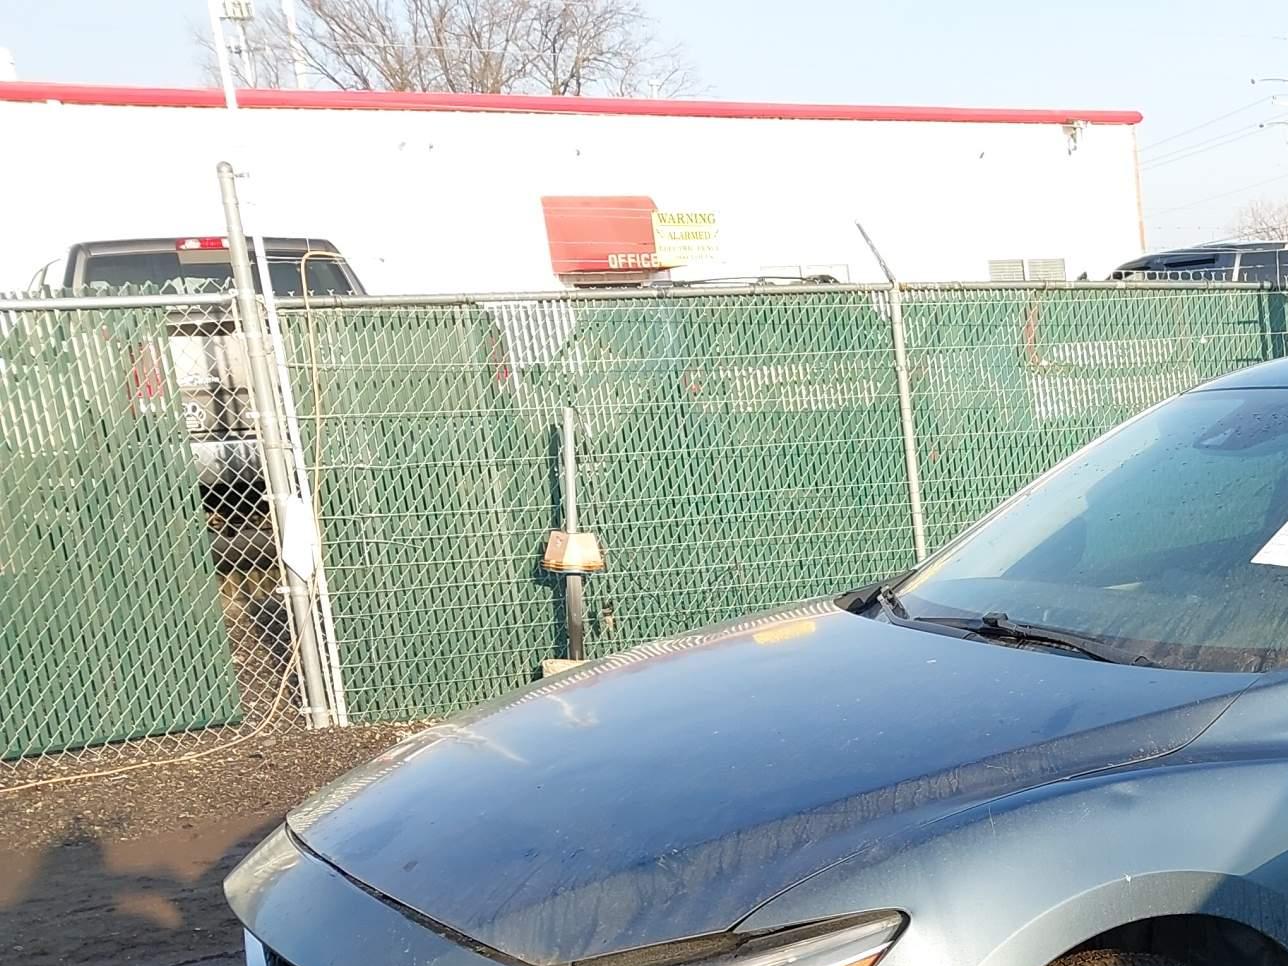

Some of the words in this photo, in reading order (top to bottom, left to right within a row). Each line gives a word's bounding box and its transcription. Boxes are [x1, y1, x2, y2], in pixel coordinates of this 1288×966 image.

[656, 212, 717, 225] WARNING
[667, 231, 711, 241] ALARMED
[608, 253, 660, 269] OFFICE
